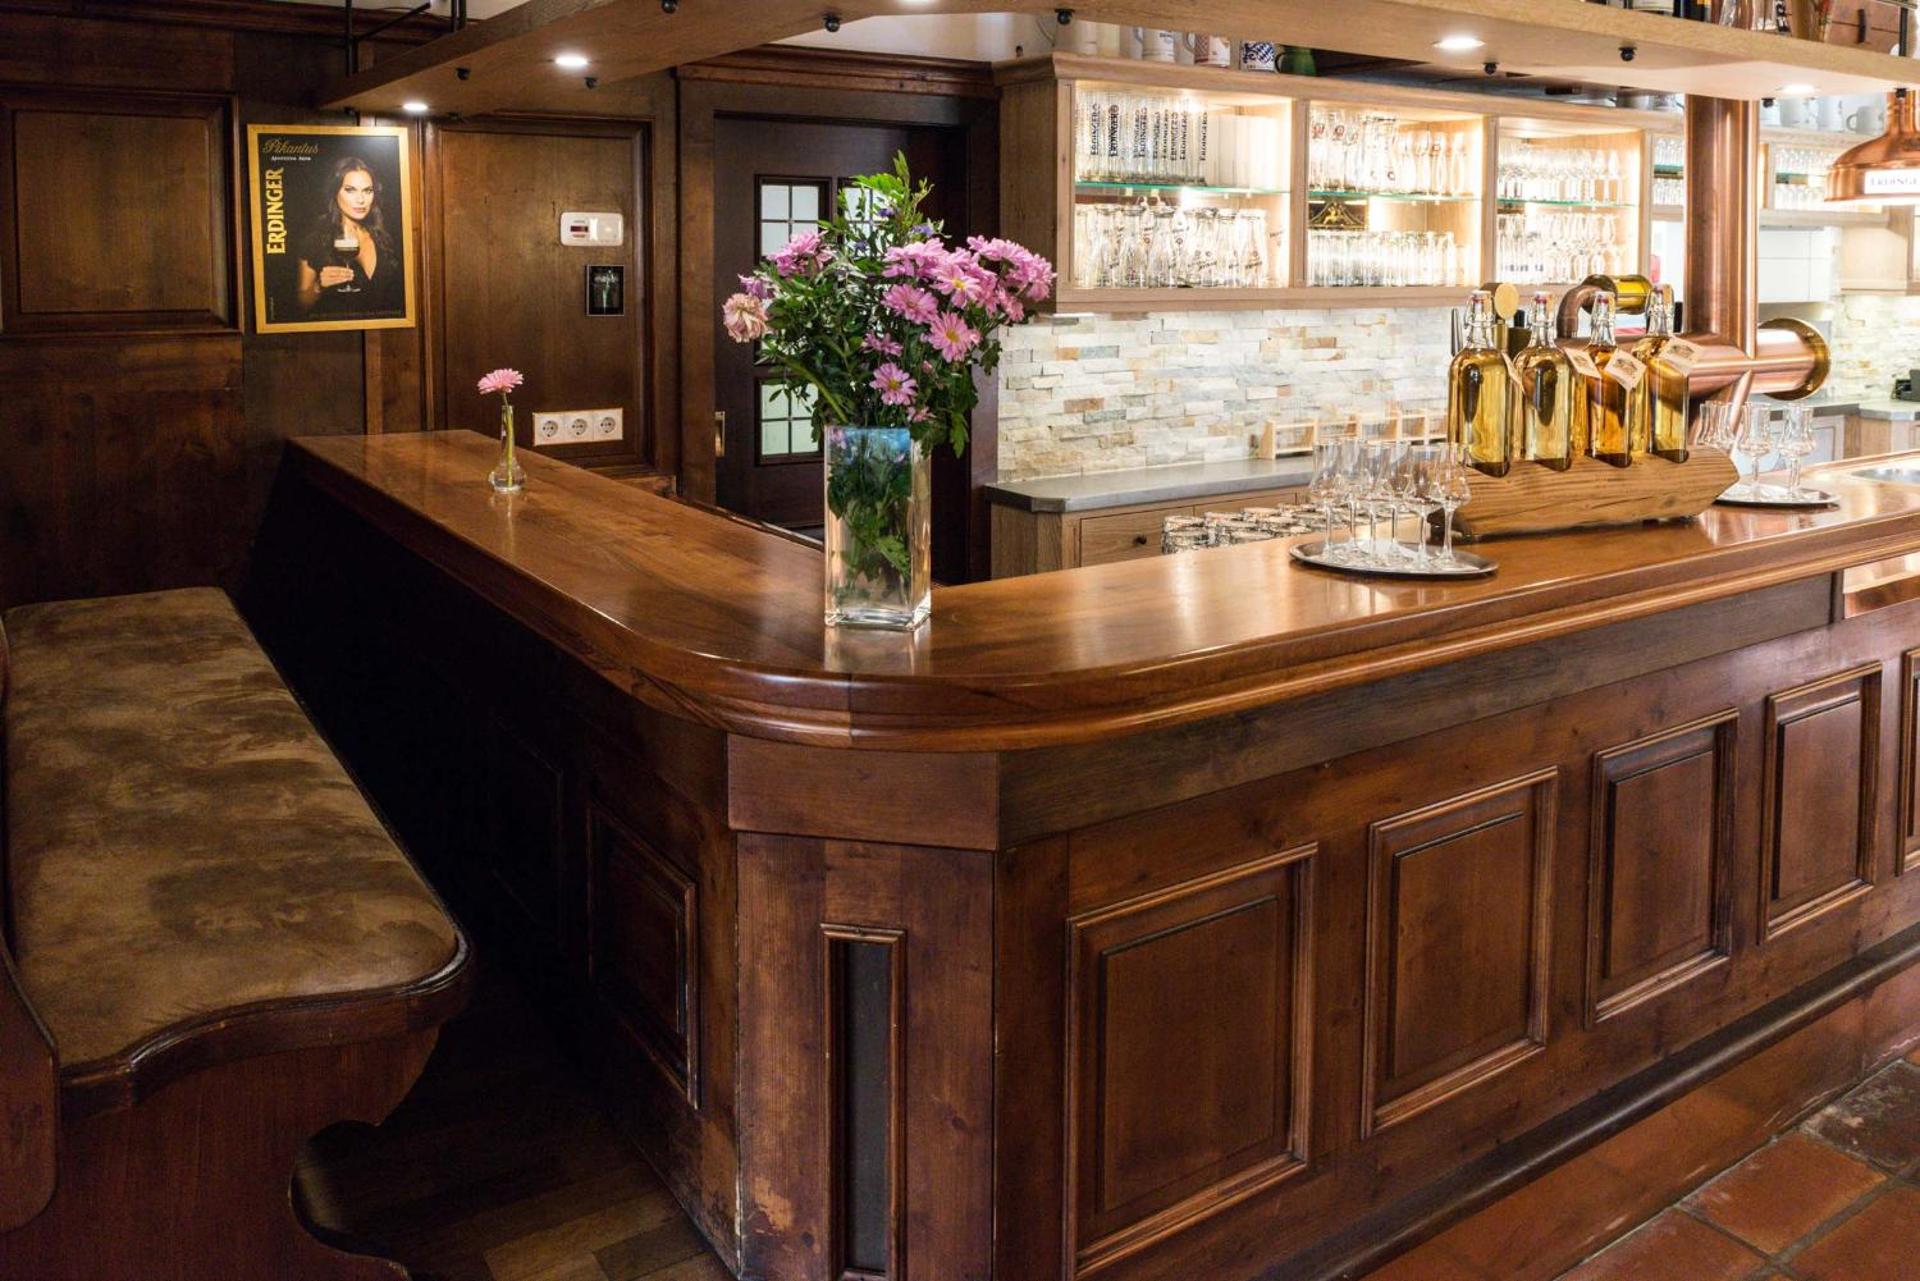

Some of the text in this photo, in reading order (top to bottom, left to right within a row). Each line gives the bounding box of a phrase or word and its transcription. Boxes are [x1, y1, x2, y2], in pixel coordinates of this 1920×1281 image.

[263, 139, 319, 154] Pikantus
[1109, 113, 1118, 157] ERDINGER
[266, 167, 287, 254] ERDINGER
